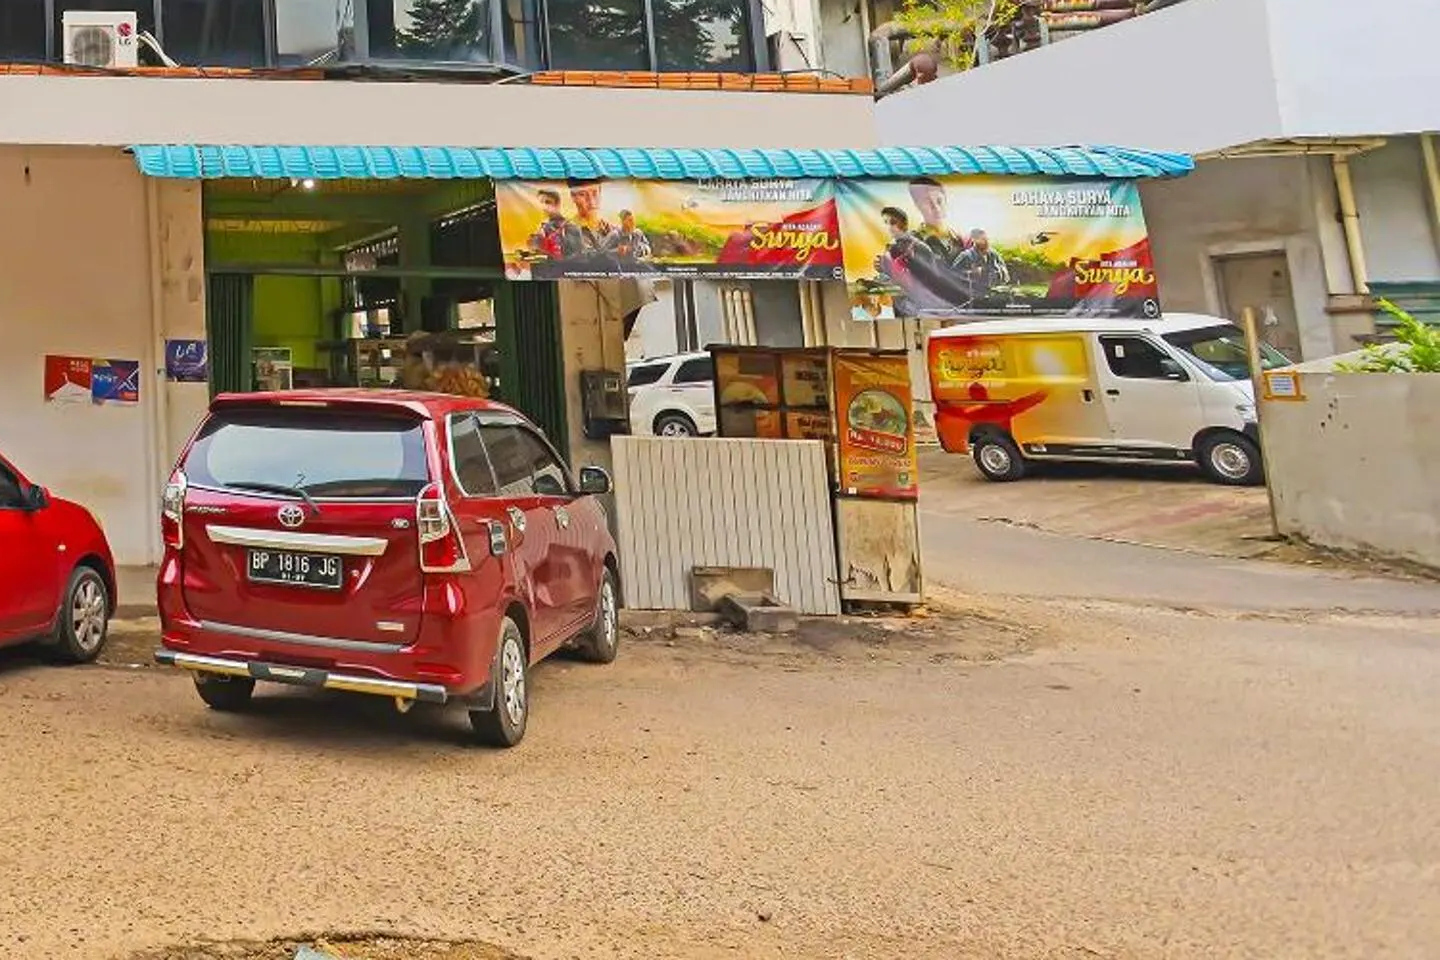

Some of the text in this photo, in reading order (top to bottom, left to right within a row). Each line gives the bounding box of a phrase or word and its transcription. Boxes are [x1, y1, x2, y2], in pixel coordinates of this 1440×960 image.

[118, 38, 132, 46] LG
[1069, 190, 1113, 205] SURYA
[750, 222, 839, 261] Surya
[1074, 260, 1155, 295] Surya
[252, 552, 270, 570] BP
[278, 554, 311, 574] 1816
[318, 558, 337, 577] JG
